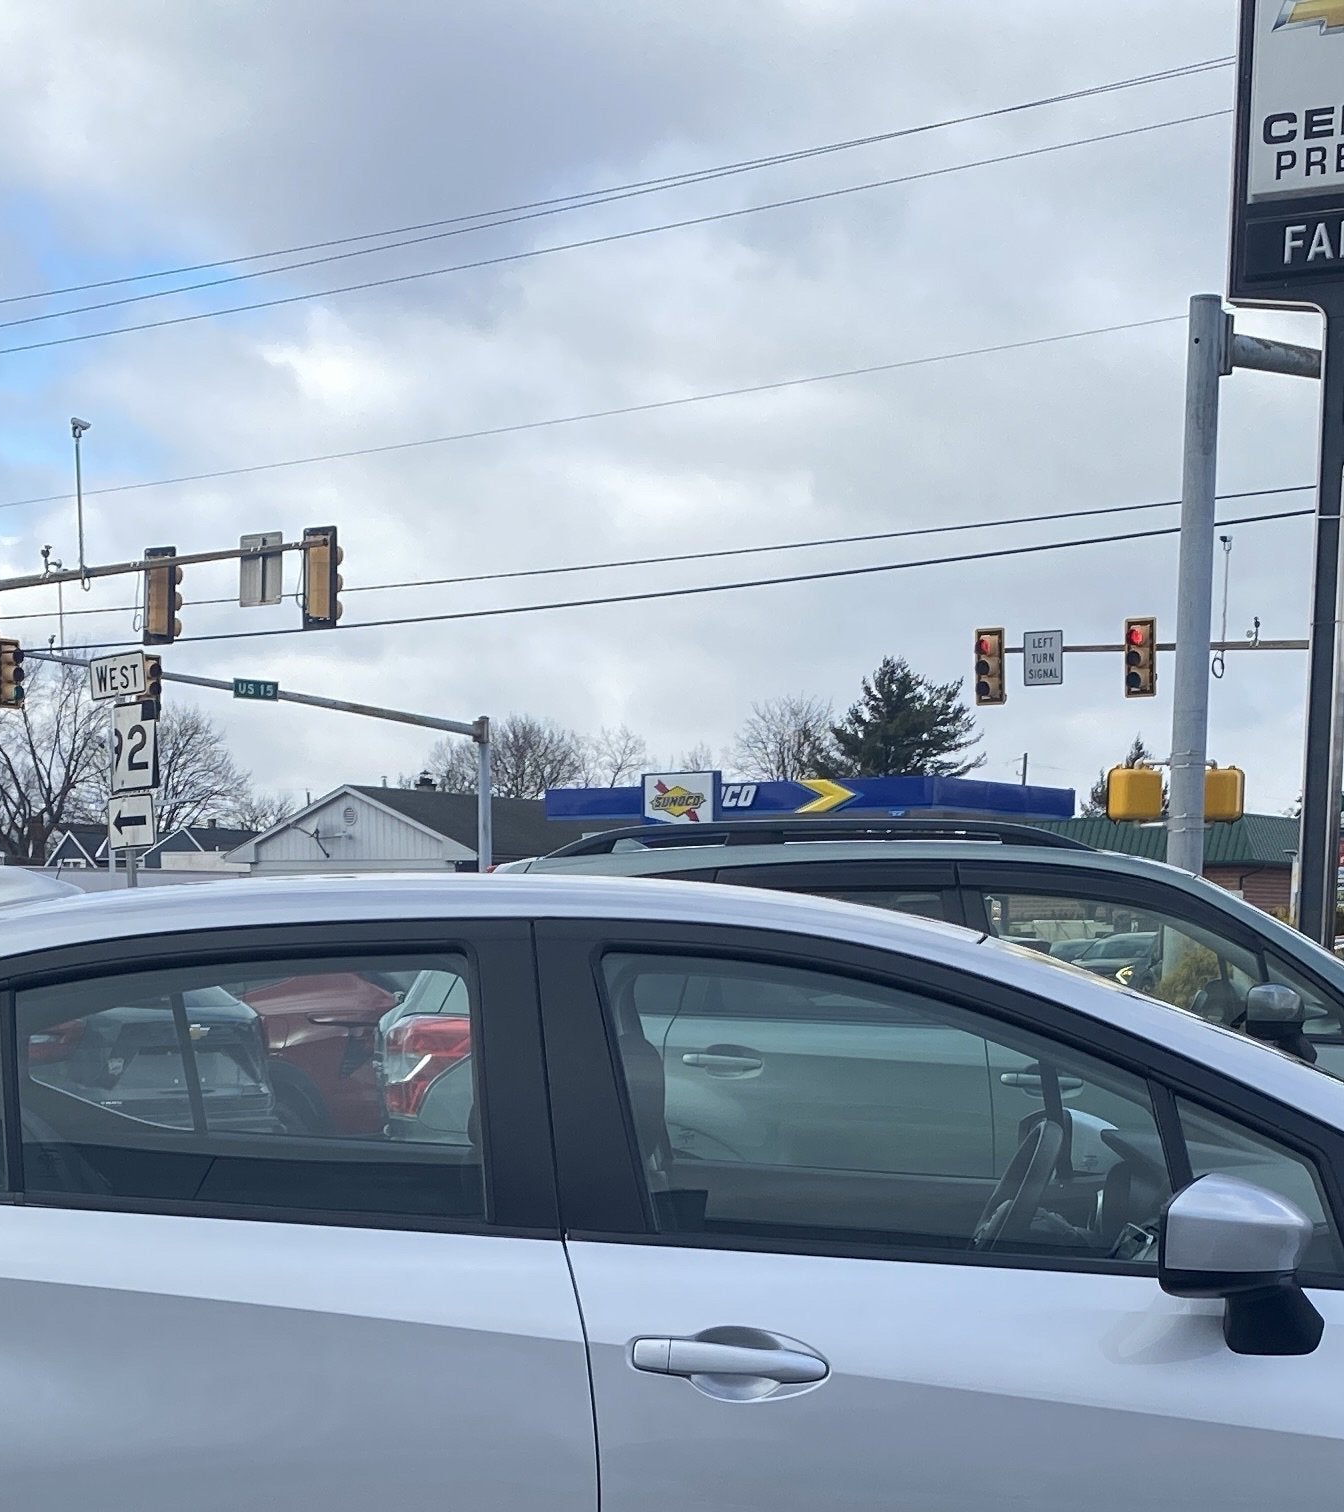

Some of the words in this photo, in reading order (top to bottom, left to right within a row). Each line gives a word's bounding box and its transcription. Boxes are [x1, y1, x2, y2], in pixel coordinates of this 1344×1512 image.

[1032, 637, 1053, 649] LEFT
[1031, 652, 1055, 664] TURN
[96, 663, 138, 692] WEST
[1028, 667, 1059, 680] SIGNAL
[238, 682, 255, 695] US
[260, 684, 274, 697] 15
[655, 795, 701, 808] SUNOCO
